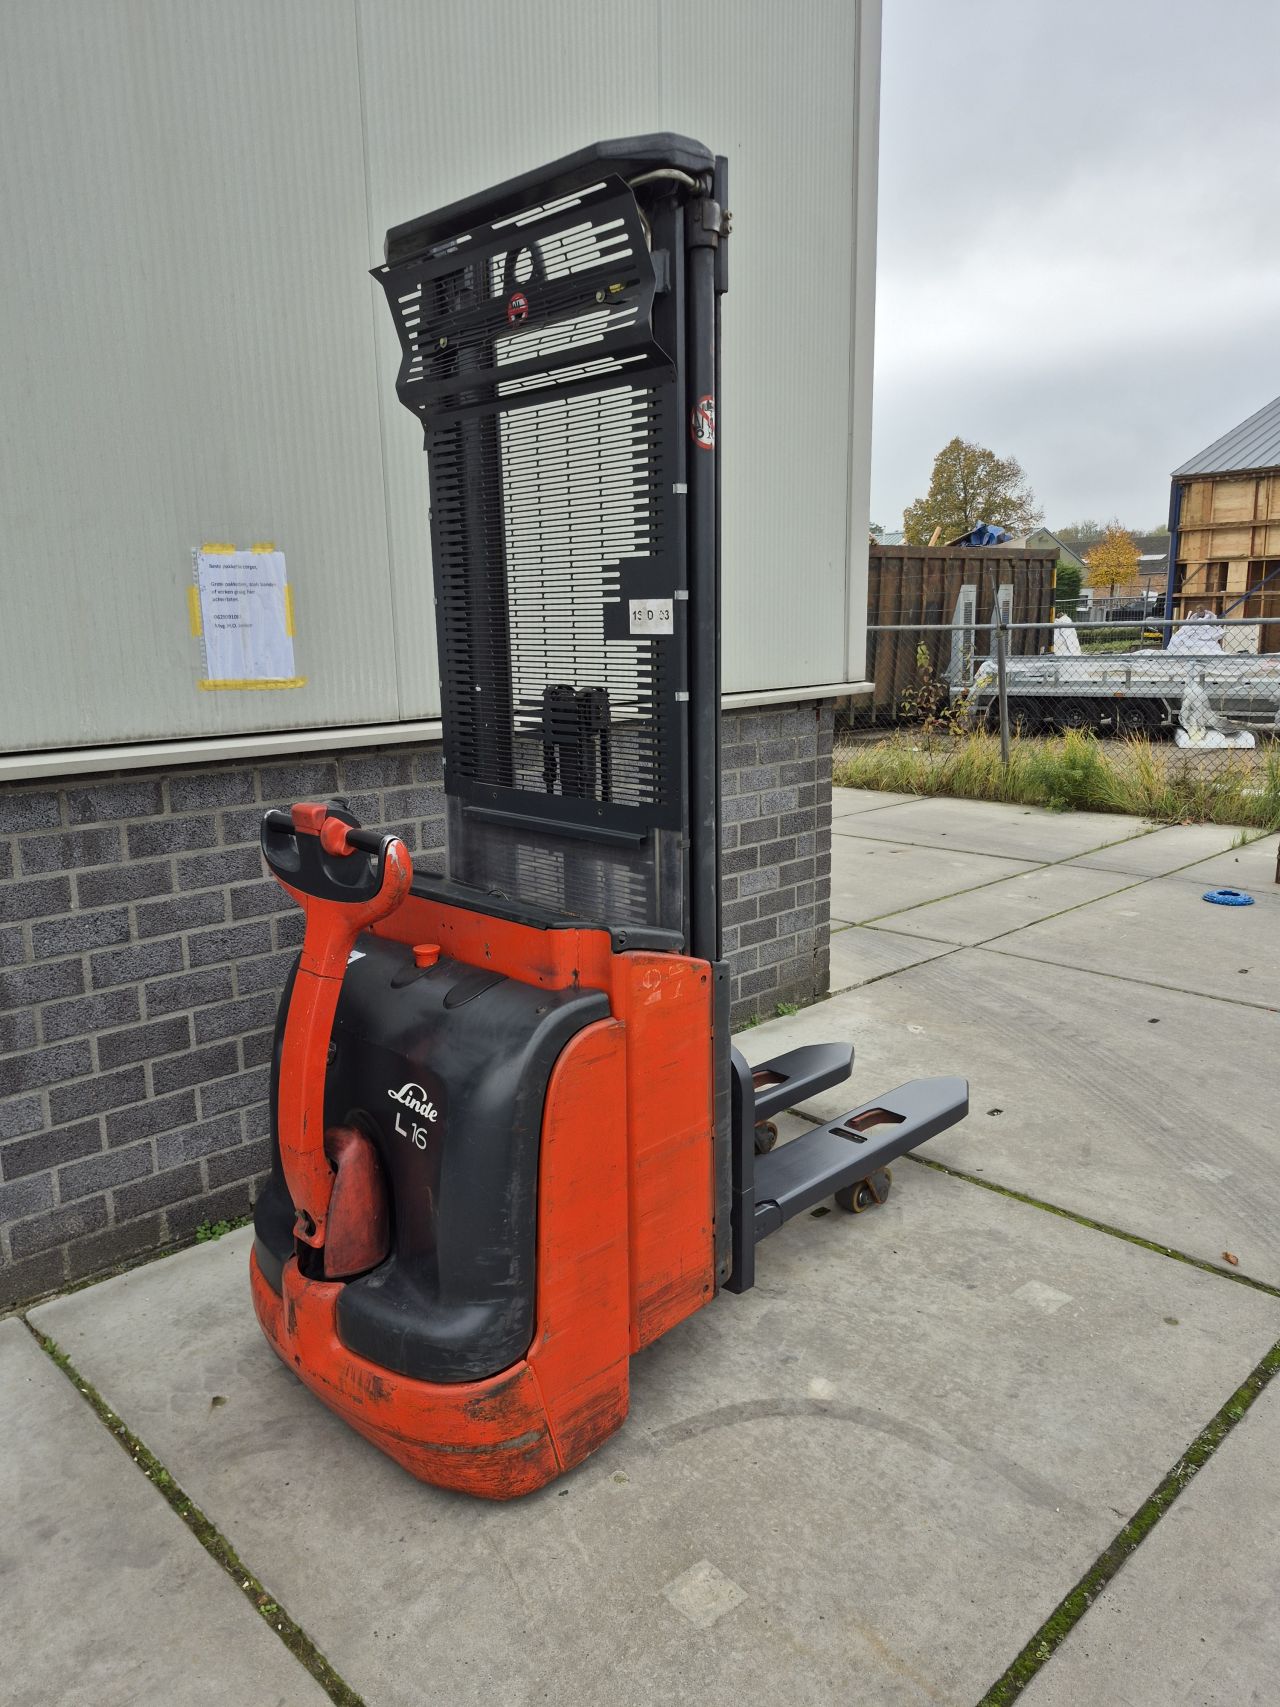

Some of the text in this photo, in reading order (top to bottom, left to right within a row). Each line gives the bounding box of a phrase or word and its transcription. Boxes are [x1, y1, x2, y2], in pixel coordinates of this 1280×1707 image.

[387, 1083, 438, 1122] Linde
[395, 1112, 428, 1150] L 16
